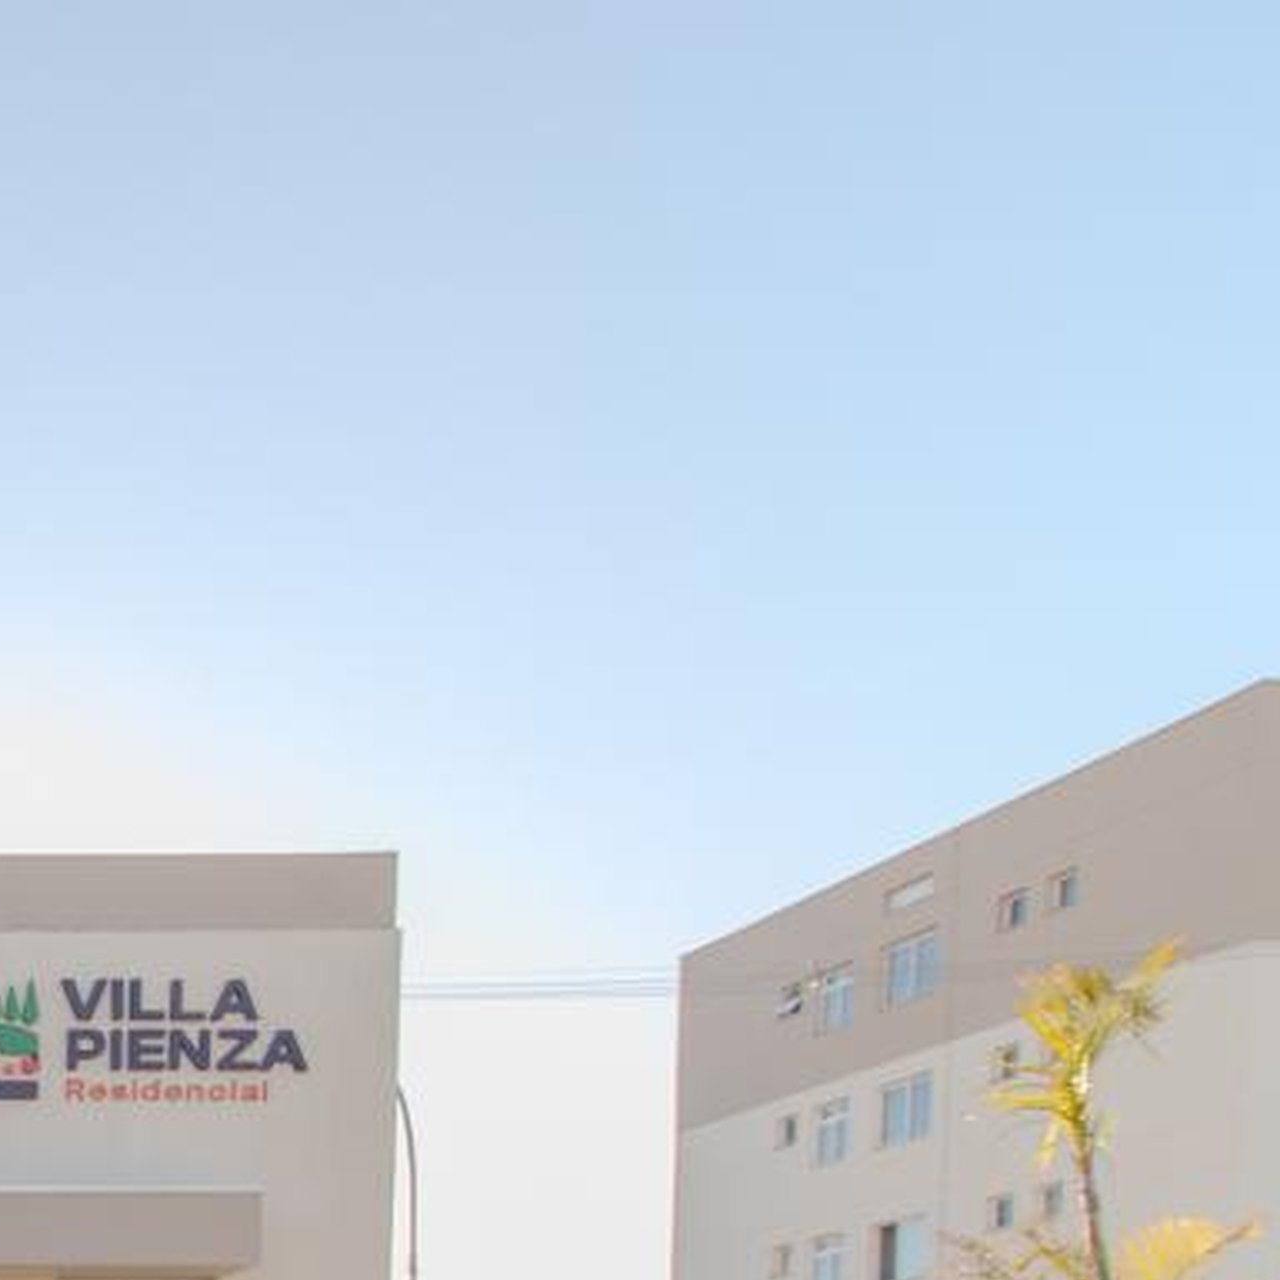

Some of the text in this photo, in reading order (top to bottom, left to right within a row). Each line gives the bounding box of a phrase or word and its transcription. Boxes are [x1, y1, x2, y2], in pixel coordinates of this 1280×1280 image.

[61, 978, 258, 1020] VILLA
[65, 1029, 308, 1072] PIENZA
[65, 1079, 269, 1102] Residencial
